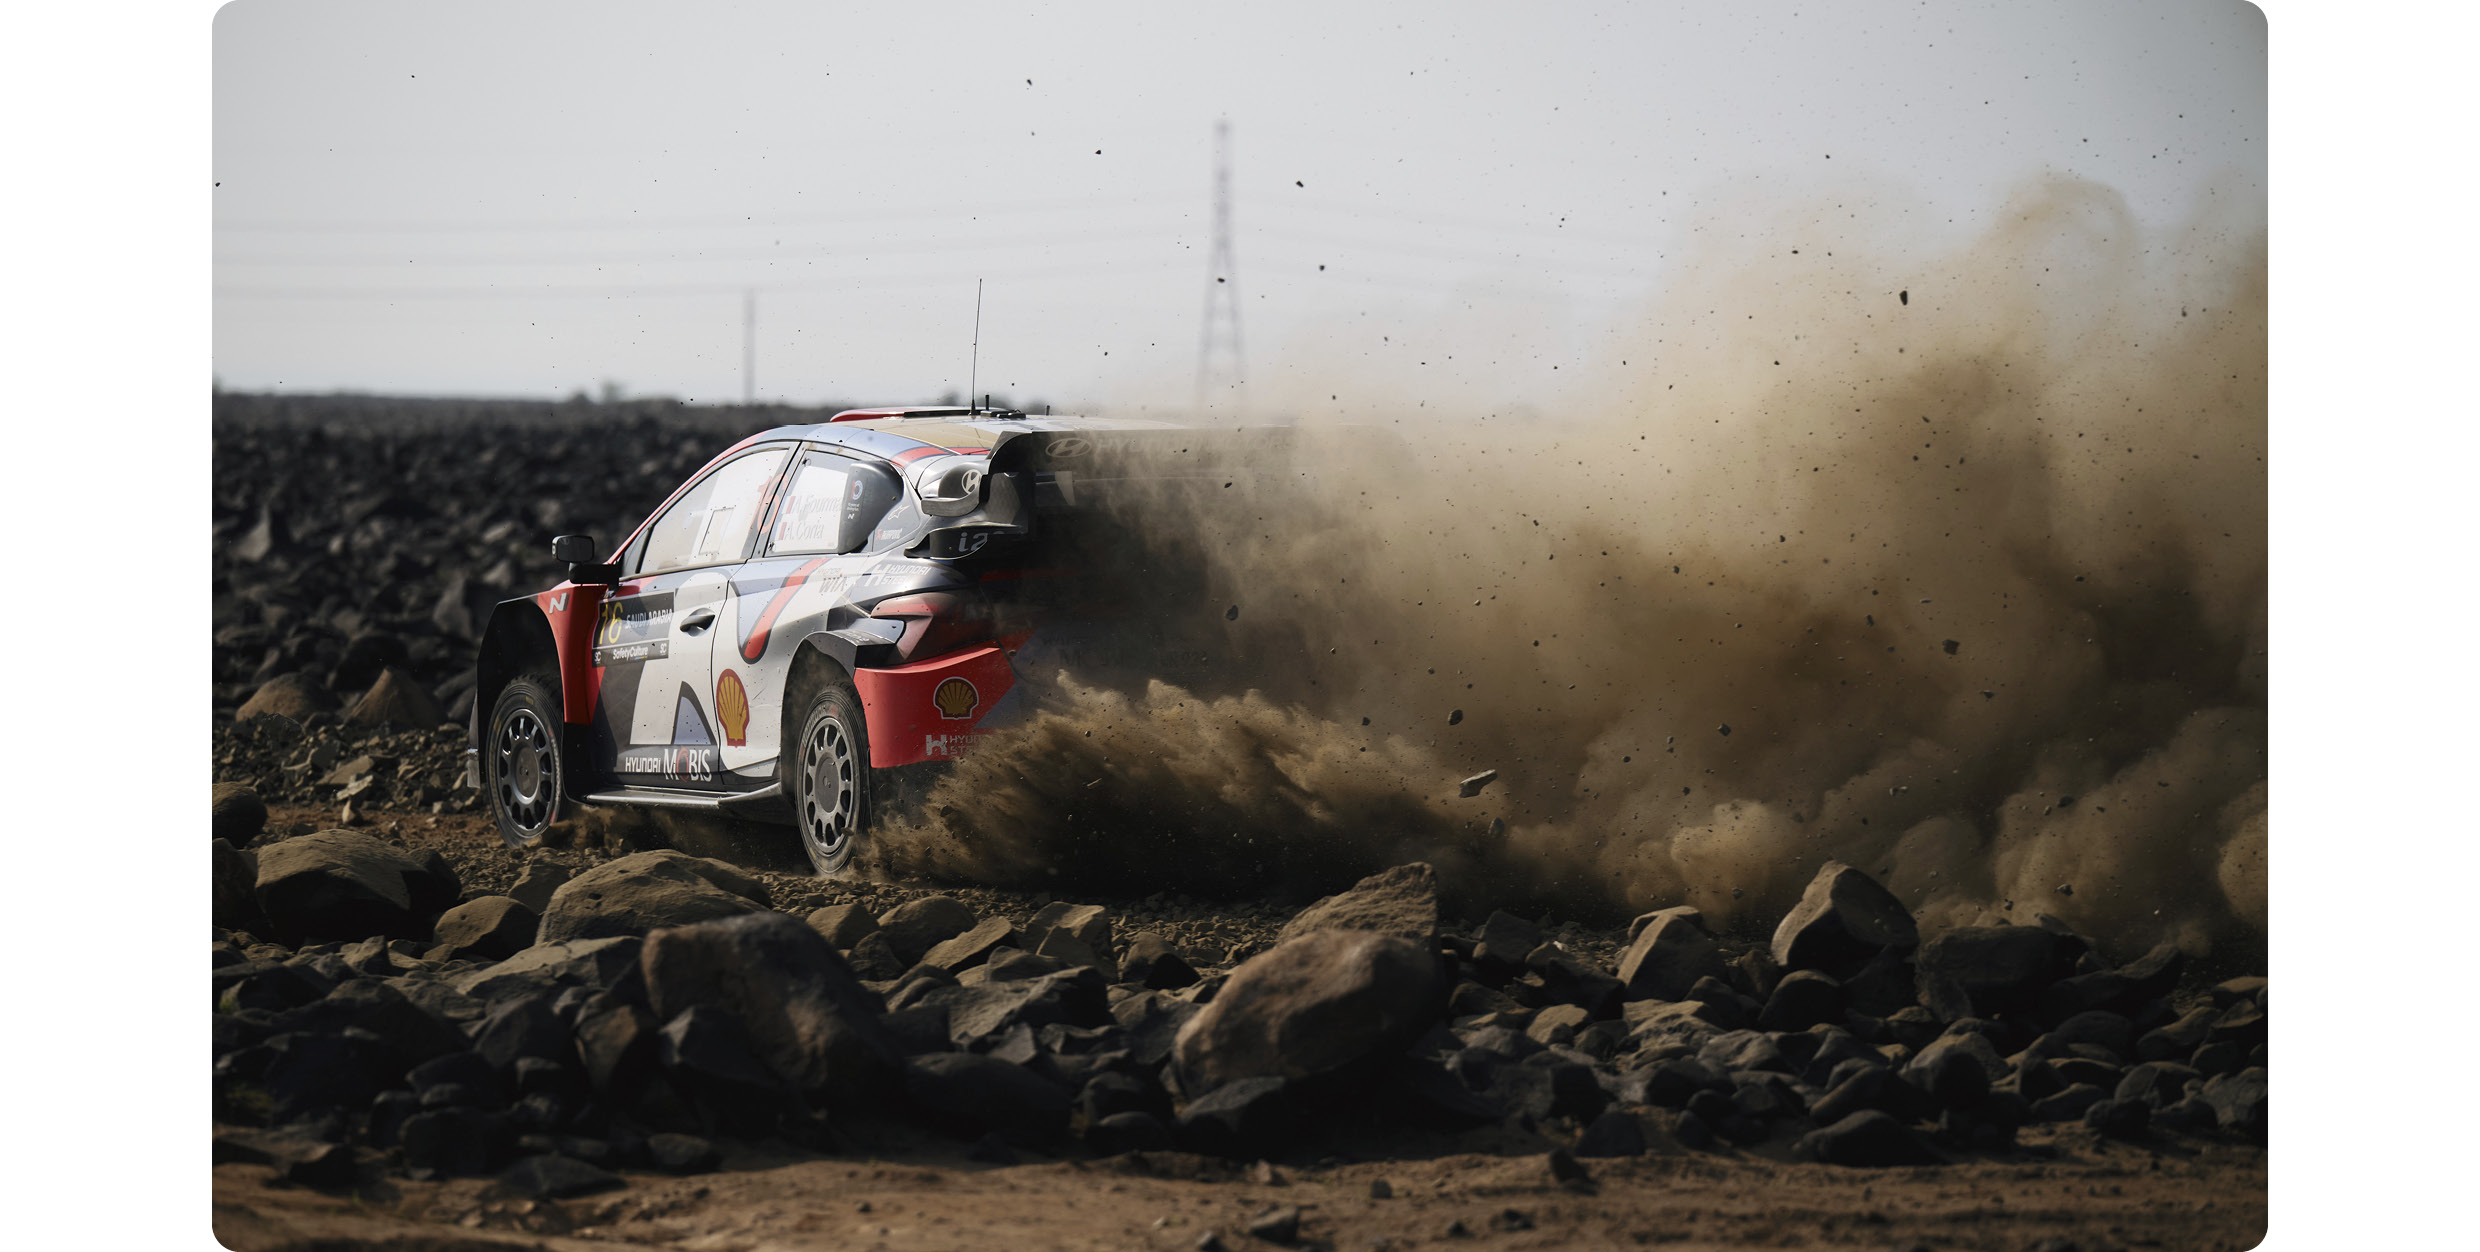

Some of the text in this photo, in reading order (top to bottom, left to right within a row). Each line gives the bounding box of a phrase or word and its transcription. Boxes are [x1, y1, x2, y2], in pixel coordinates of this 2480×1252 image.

[890, 564, 931, 576] HYUNDAI
[549, 592, 567, 614] N
[599, 601, 673, 644] 16 SAUDI ARABIA
[612, 645, 649, 661] SafetyCulture
[625, 747, 712, 783] HYUNDAI MOBIS
